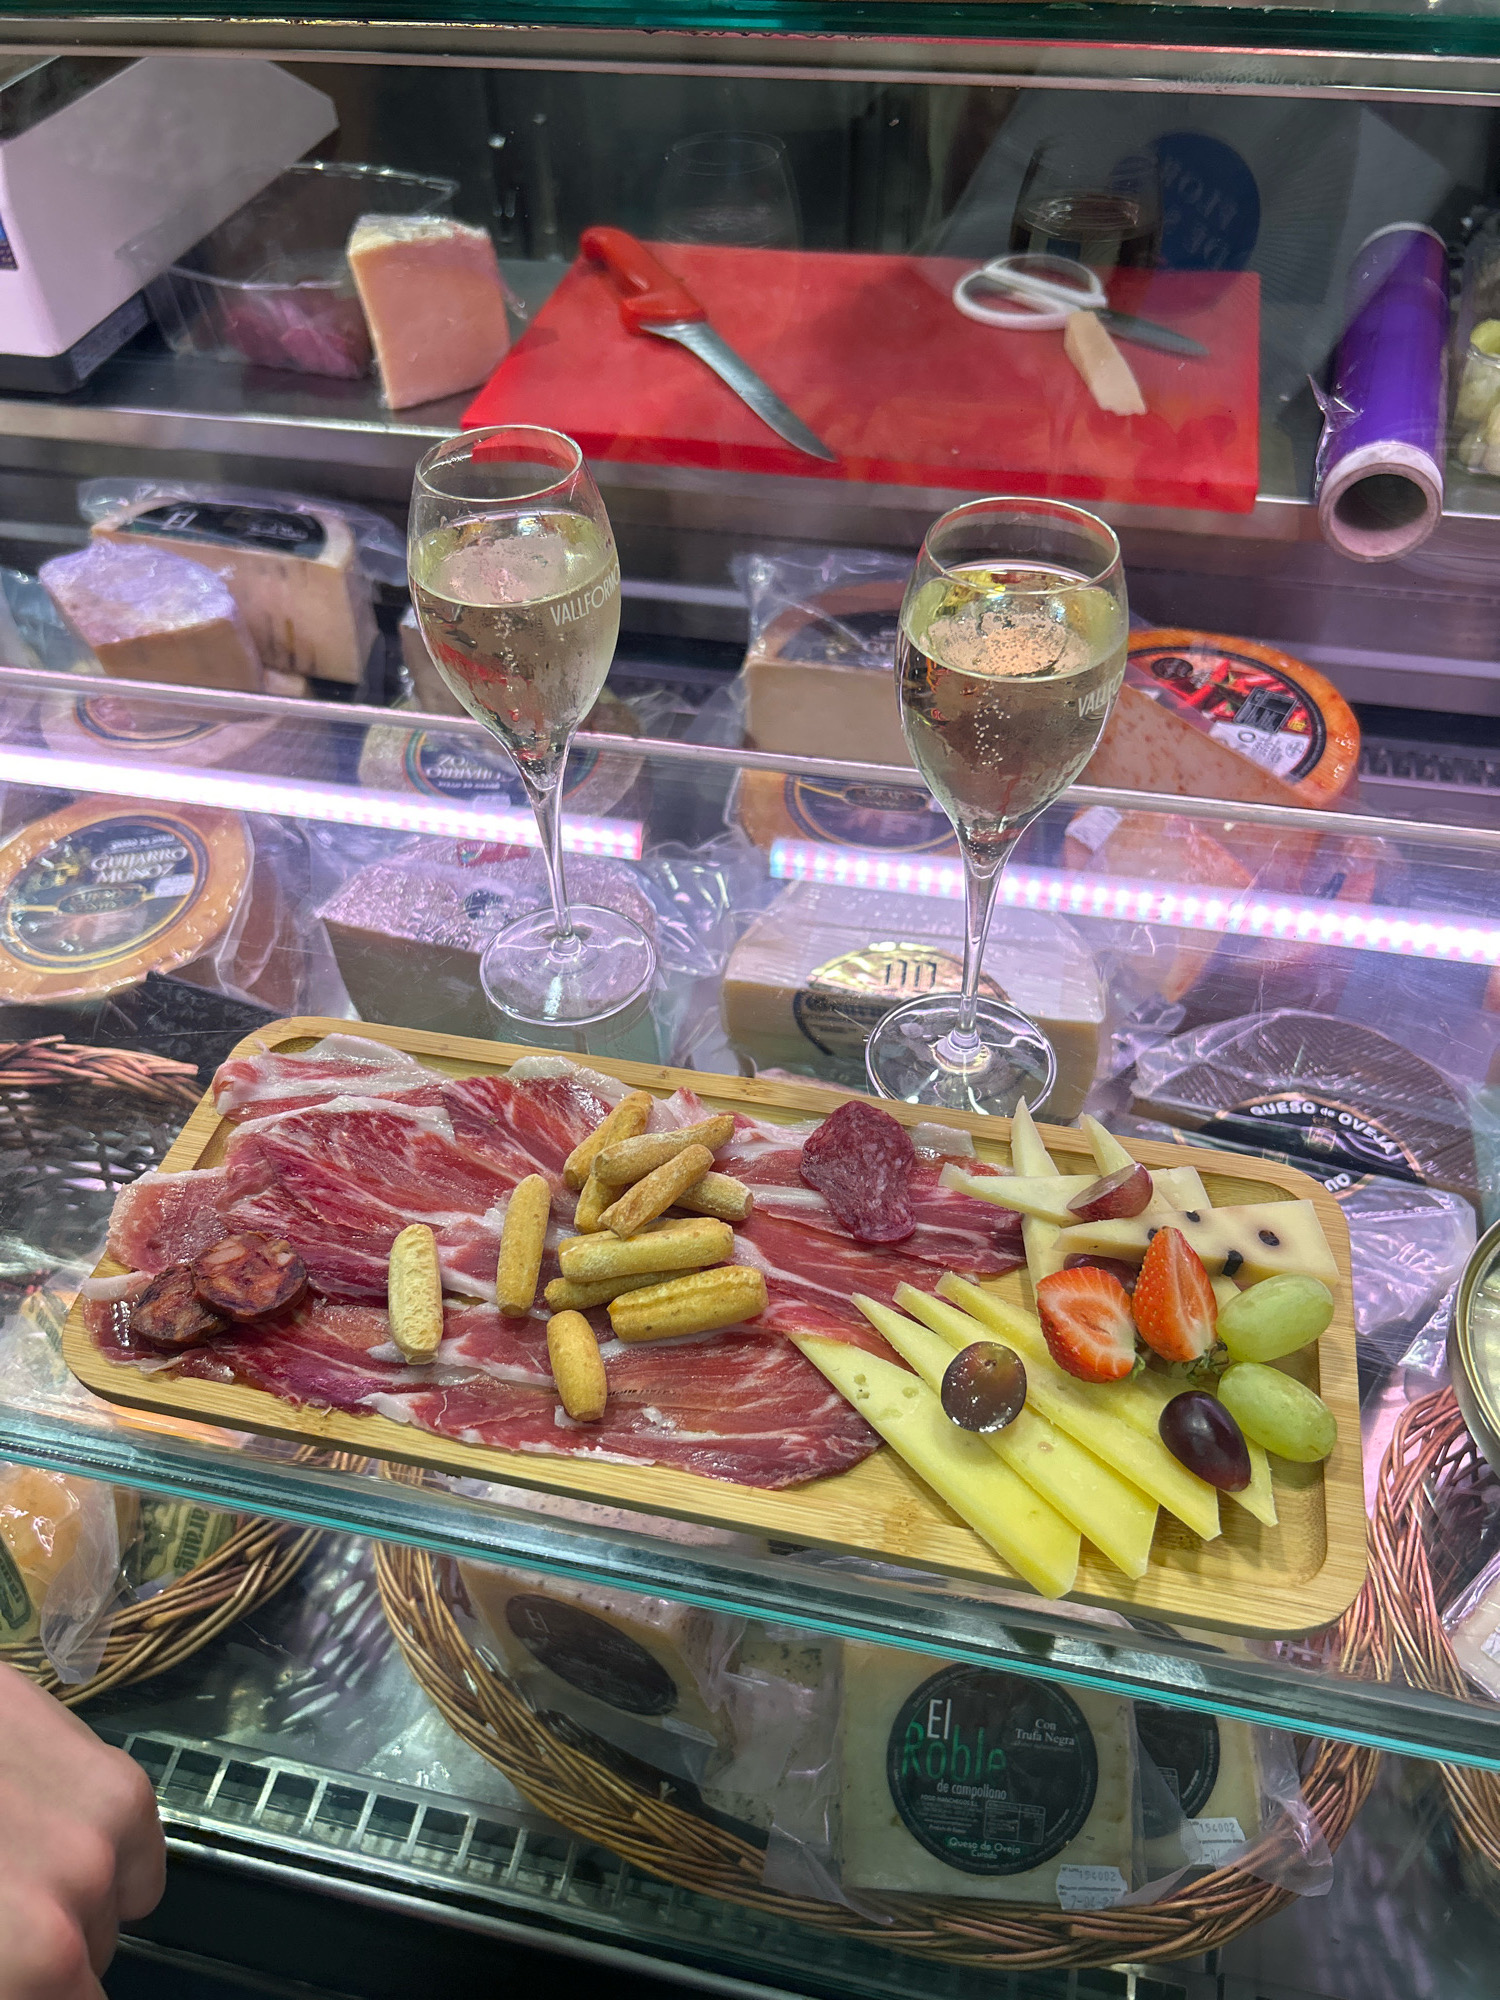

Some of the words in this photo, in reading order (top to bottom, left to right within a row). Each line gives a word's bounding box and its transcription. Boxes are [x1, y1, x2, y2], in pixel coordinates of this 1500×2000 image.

[1250, 1100, 1317, 1116] QUESO
[1319, 1107, 1335, 1118] de
[1338, 1112, 1397, 1155] OVEJA
[1322, 1172, 1352, 1193] QU
[926, 1699, 951, 1739] El
[1035, 1718, 1057, 1732] Con
[1015, 1728, 1042, 1742] Trufa
[1045, 1732, 1075, 1746] Negra
[902, 1721, 1007, 1782] Roble
[937, 1779, 950, 1793] de
[949, 1837, 978, 1850] Queso
[979, 1840, 992, 1851] de
[994, 1843, 1021, 1856] Oveja
